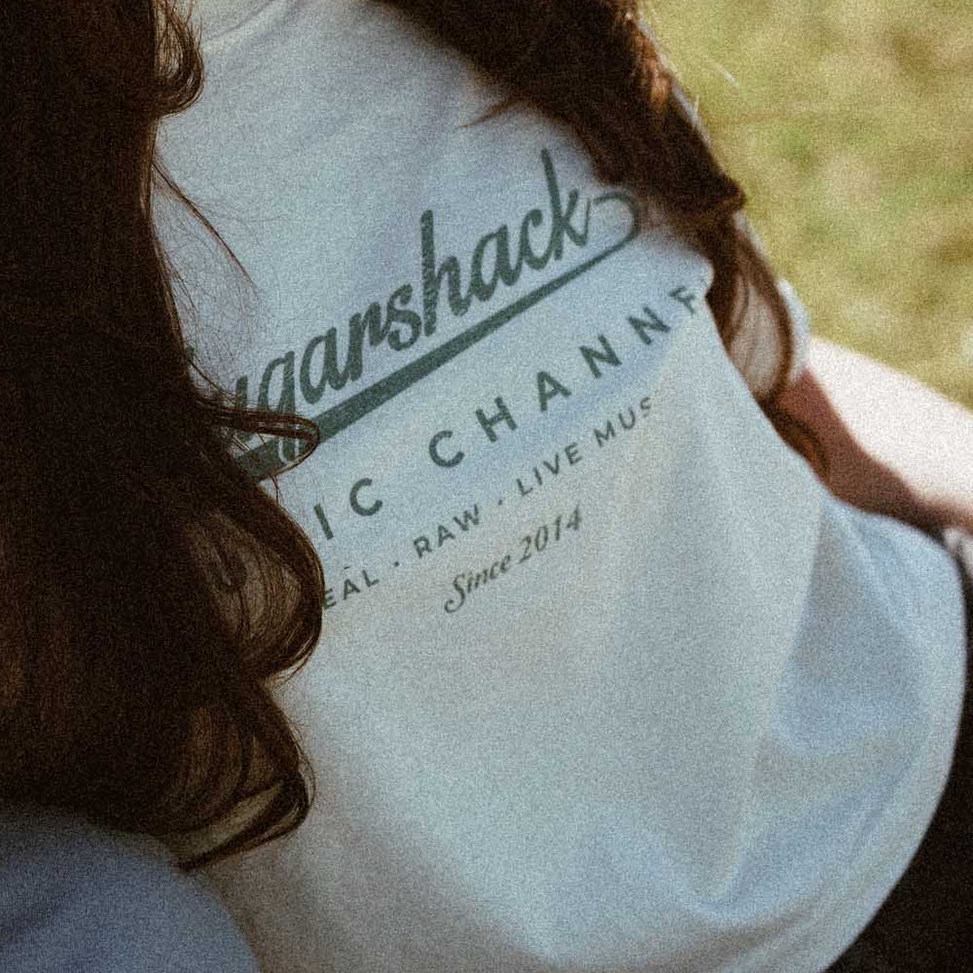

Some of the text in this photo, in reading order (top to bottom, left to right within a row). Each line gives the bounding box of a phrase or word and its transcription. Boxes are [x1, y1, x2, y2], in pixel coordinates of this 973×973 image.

[313, 477, 383, 540] IC
[322, 395, 652, 610] EAL RAW LIVE MUS
[444, 503, 583, 614] Since 2014
